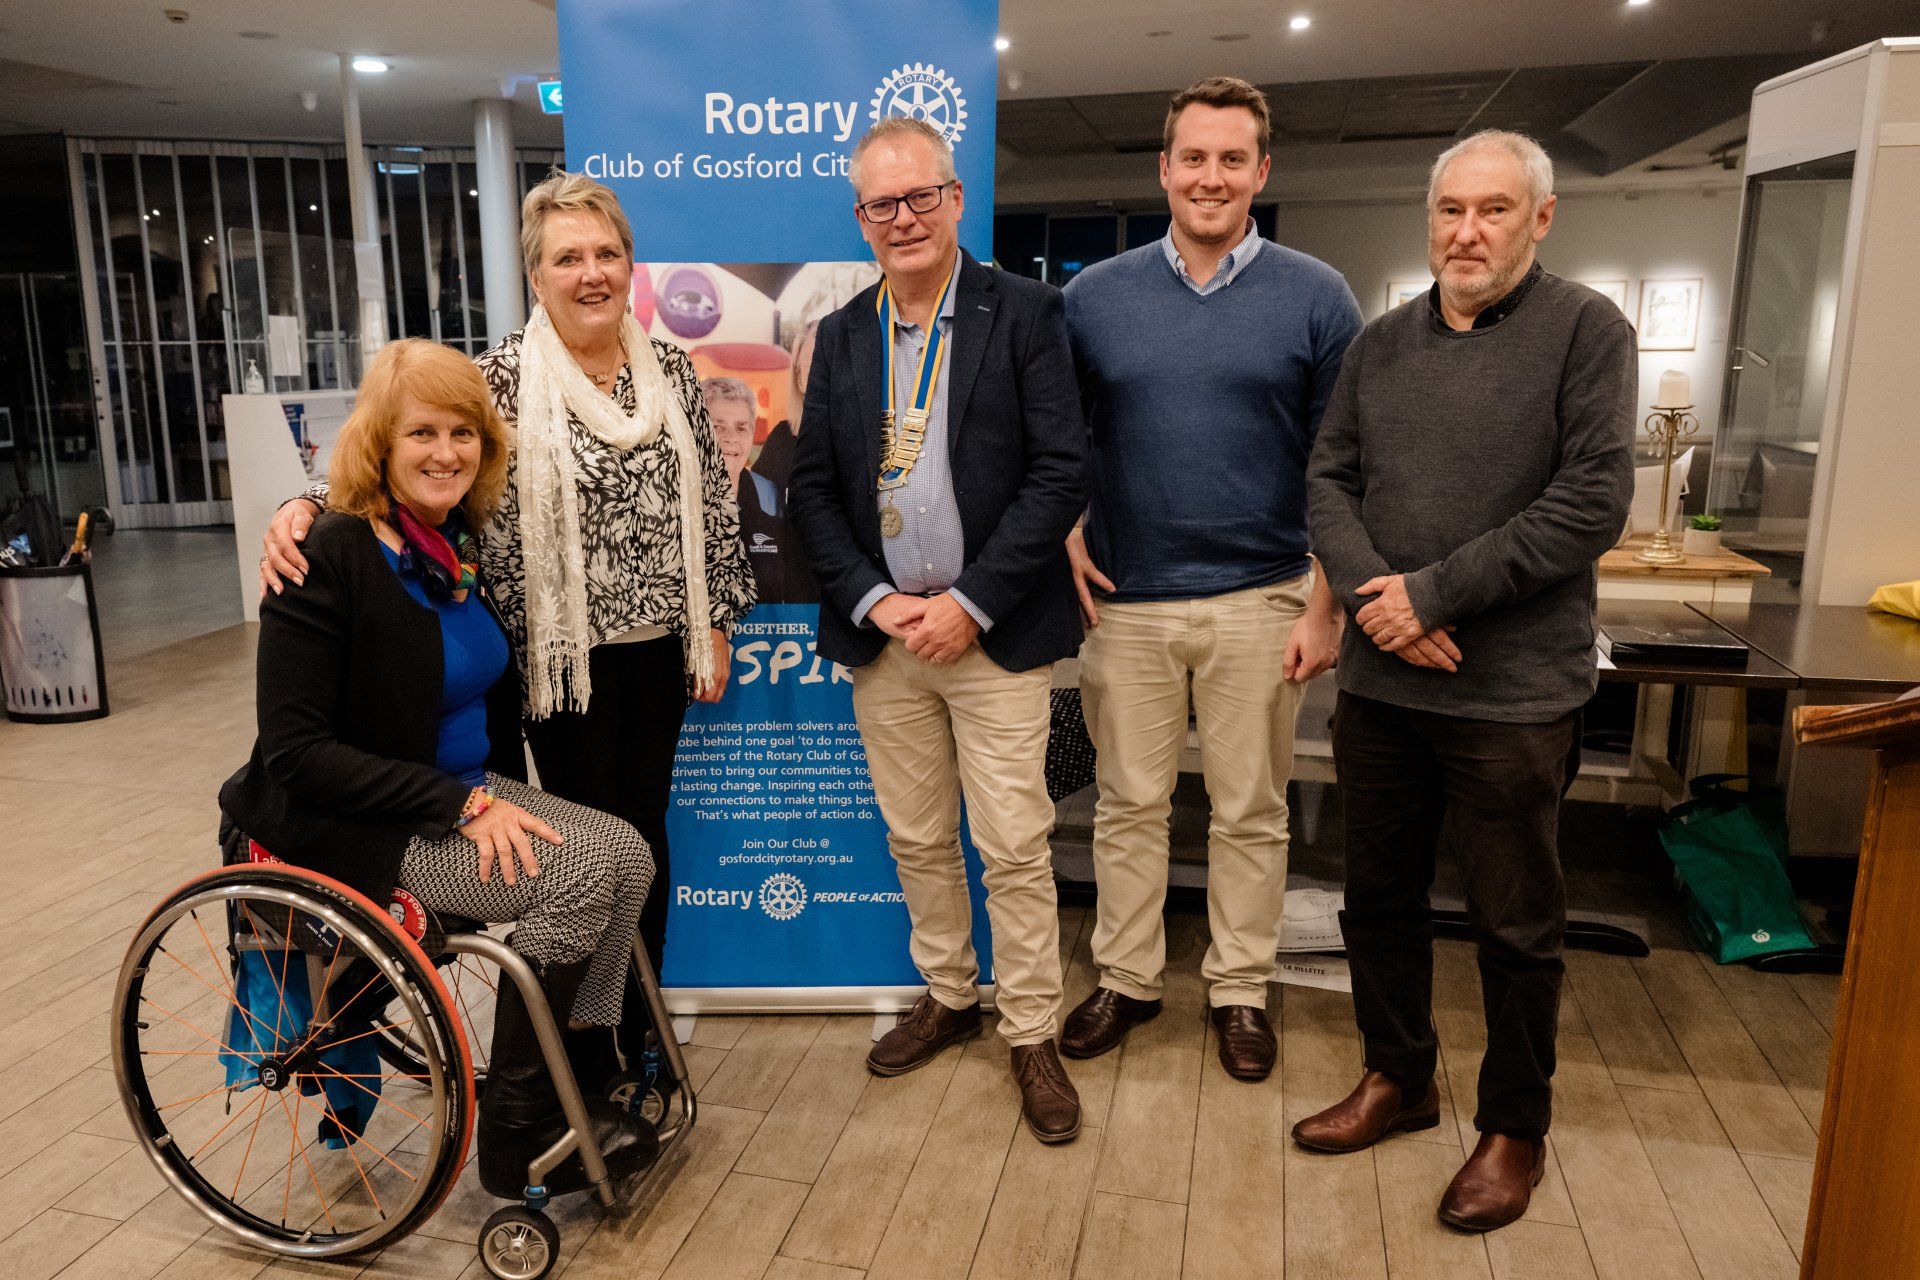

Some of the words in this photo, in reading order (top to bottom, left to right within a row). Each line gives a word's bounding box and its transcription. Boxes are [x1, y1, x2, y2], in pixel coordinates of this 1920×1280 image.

[897, 74, 940, 87] ROTARY
[705, 92, 858, 142] Rotary
[584, 152, 645, 179] Club
[654, 152, 684, 178] of
[693, 152, 802, 179] Gosford
[812, 151, 853, 177] Cit
[733, 623, 815, 636] OGETHER,
[680, 723, 705, 734] tary
[709, 721, 743, 732] unites
[746, 720, 793, 733] problem
[796, 720, 833, 731] solvers
[677, 737, 700, 747] obe
[703, 736, 742, 747] behind
[745, 738, 767, 746] one
[770, 735, 795, 748] goal
[816, 735, 832, 746] do
[674, 751, 726, 762] members
[729, 750, 741, 761] of
[744, 751, 763, 760] the
[766, 751, 803, 763] Rotary
[806, 750, 831, 760] Club
[834, 750, 847, 760] of
[672, 766, 707, 777] driven
[710, 767, 722, 776] to
[726, 766, 755, 778] bring
[759, 767, 777, 775] our
[781, 765, 851, 775] communities
[681, 781, 717, 793] lasting
[721, 780, 764, 793] change.
[768, 780, 816, 792] Inspiring
[819, 780, 845, 790] each
[848, 780, 874, 790] othe
[677, 798, 696, 806] our
[700, 795, 766, 805] connections
[769, 796, 782, 805] to
[784, 794, 815, 805] make
[818, 794, 853, 807] things
[855, 795, 880, 805] bett
[731, 809, 760, 820] what
[764, 809, 802, 822] people
[805, 809, 817, 819] of
[820, 809, 855, 819] action
[857, 809, 876, 819] do.
[742, 838, 764, 849] Join
[767, 838, 788, 849] Our
[792, 838, 817, 848] Club
[820, 838, 830, 848] @
[719, 853, 853, 866] gosfordcityrotary.org.au
[676, 885, 753, 910] Rotary
[812, 892, 857, 903] PEOPLE
[858, 893, 870, 901] OF
[869, 892, 906, 903] ACTIO
[408, 897, 422, 915] FOR
[1294, 966, 1326, 975] VILLETTE
